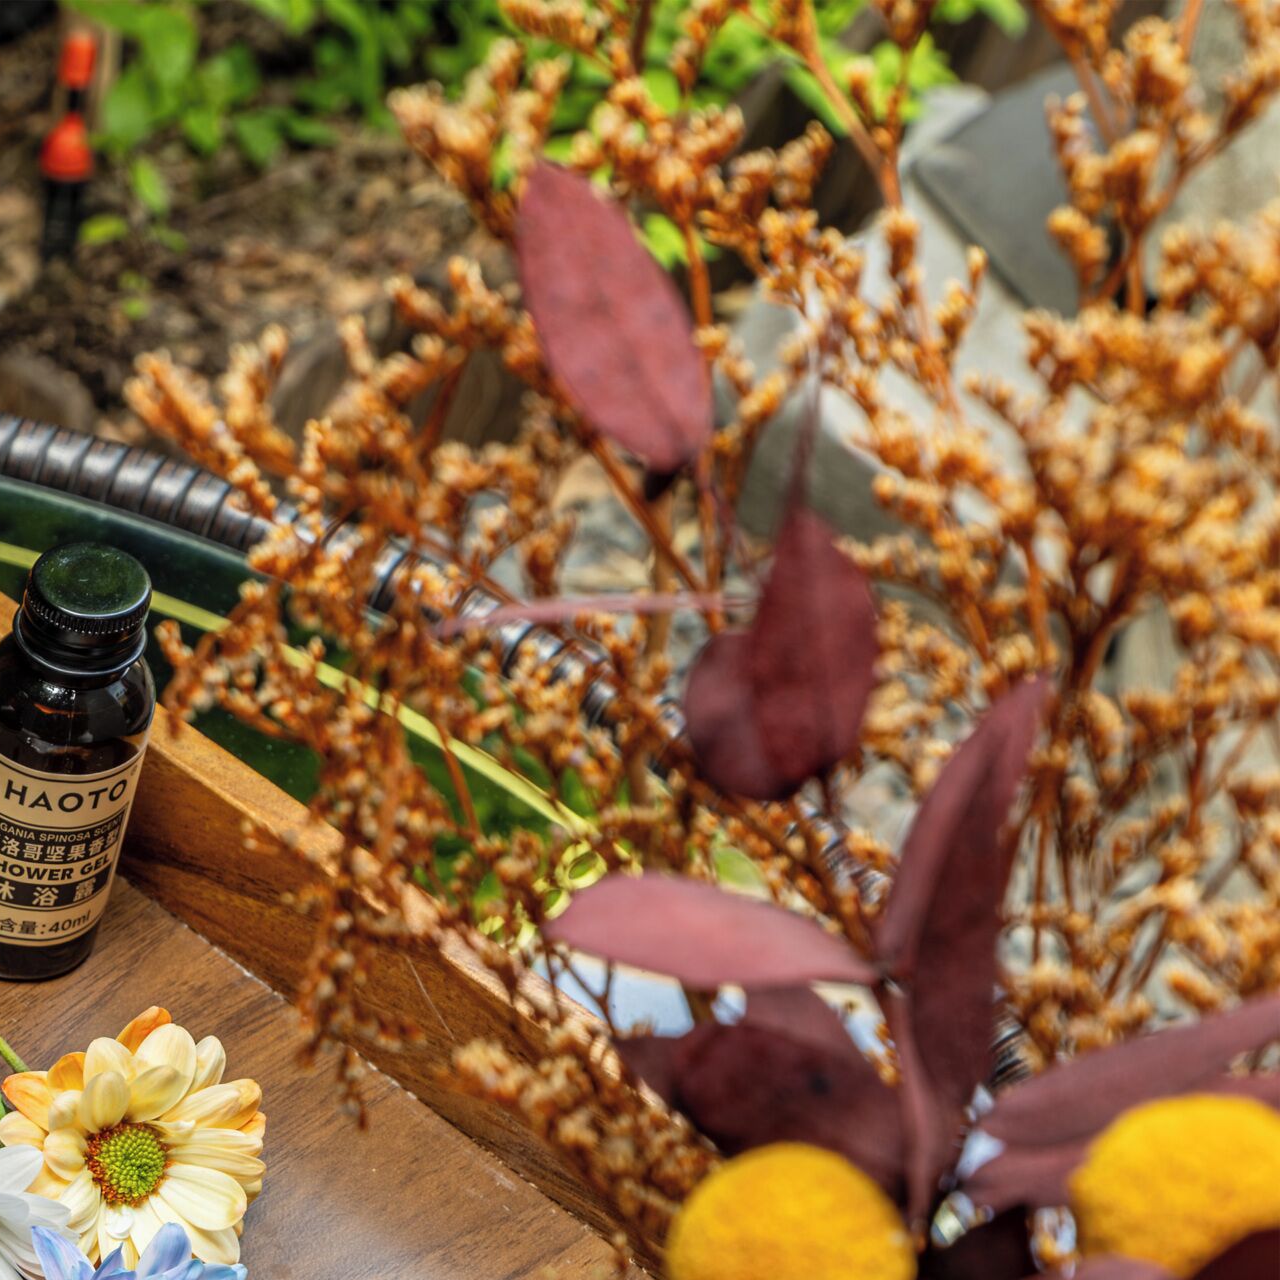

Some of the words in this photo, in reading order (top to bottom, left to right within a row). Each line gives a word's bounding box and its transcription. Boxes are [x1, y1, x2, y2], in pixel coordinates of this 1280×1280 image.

[4, 779, 128, 813] HAOTO
[39, 832, 91, 843] SPINOSA
[80, 854, 110, 875] GEL
